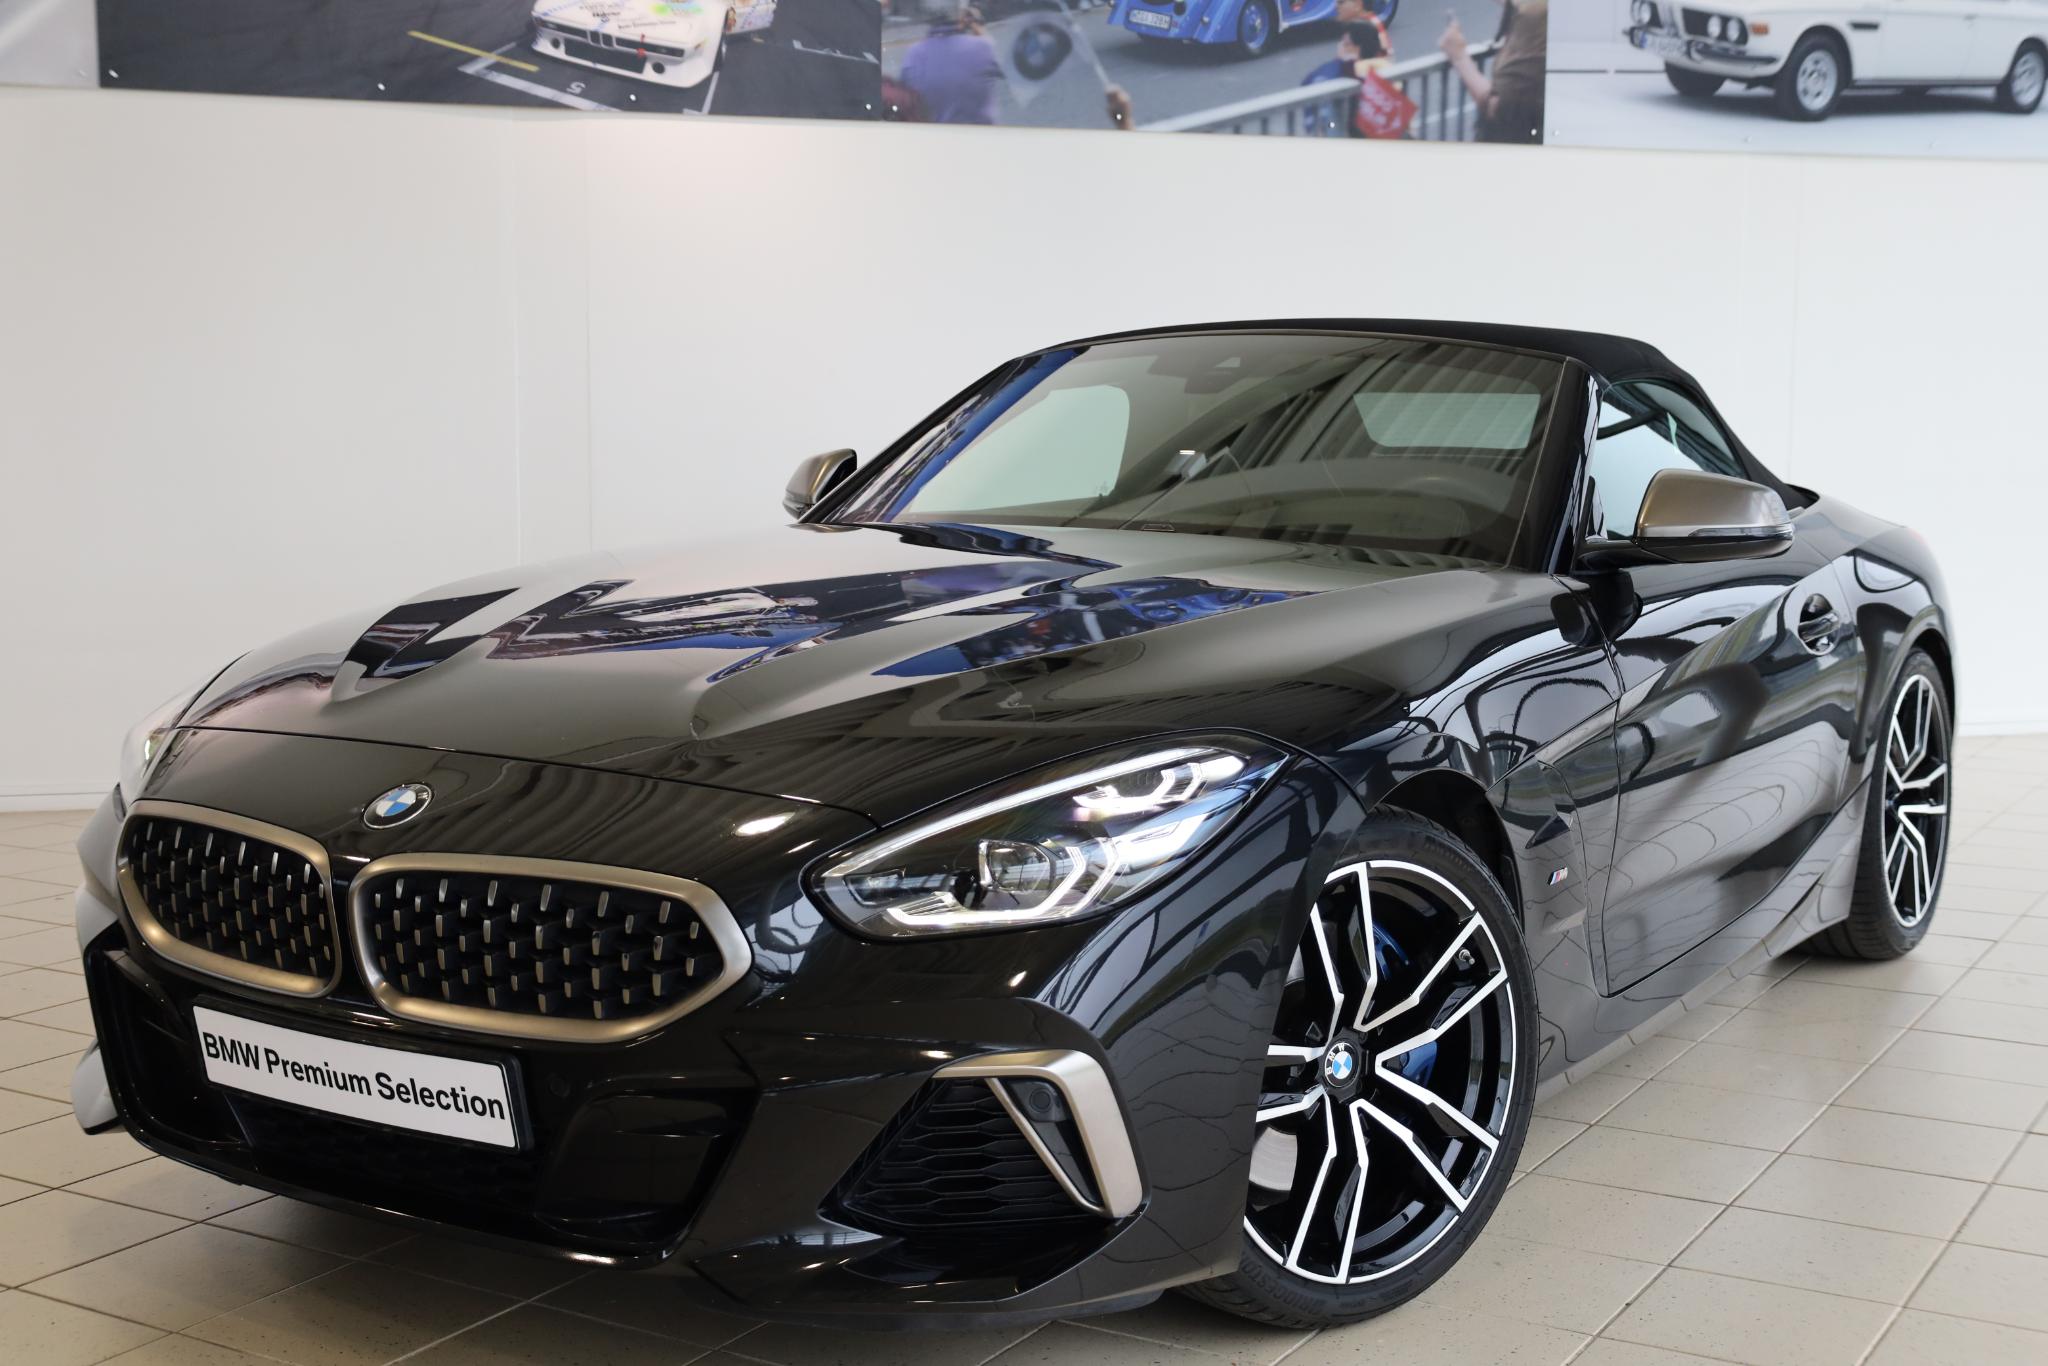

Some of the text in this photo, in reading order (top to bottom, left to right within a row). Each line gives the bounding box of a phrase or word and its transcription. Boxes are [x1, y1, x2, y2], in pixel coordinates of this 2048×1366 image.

[202, 1031, 506, 1120] BMW Premium Selection
